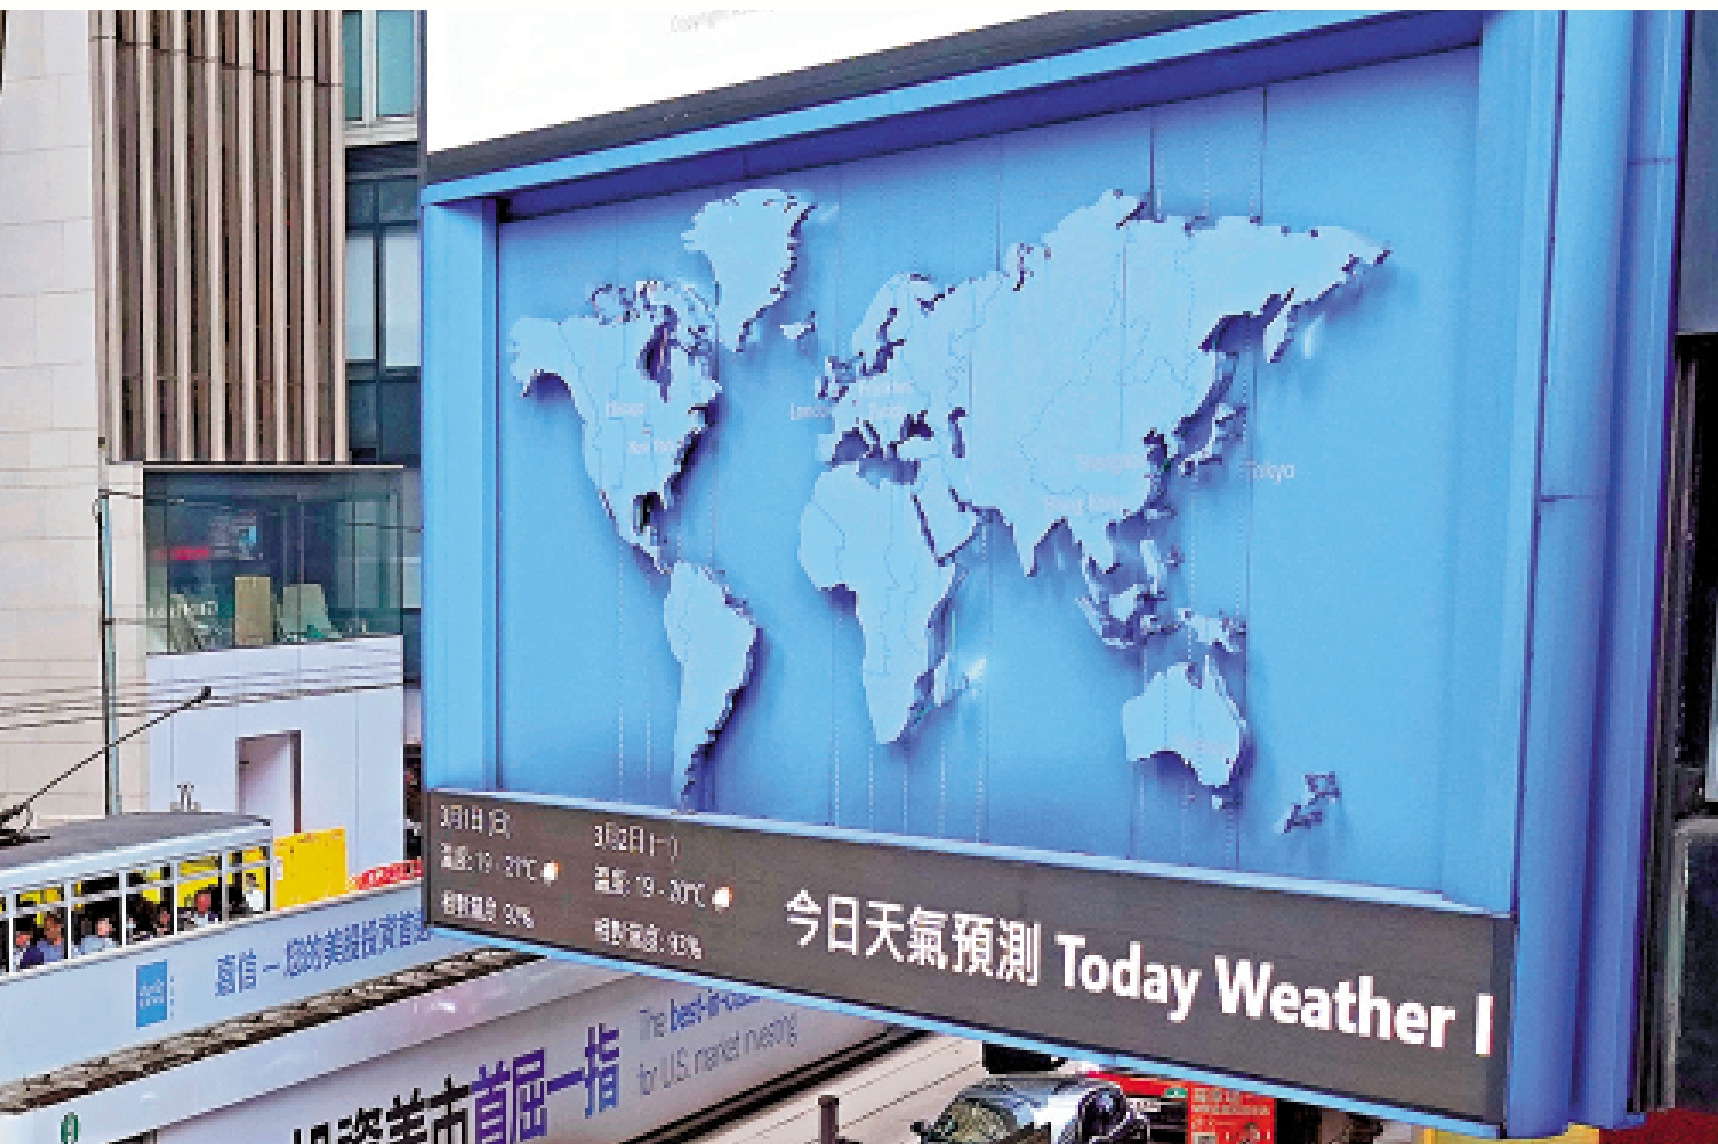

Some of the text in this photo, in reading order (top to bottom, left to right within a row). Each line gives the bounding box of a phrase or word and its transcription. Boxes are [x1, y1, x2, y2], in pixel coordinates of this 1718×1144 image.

[785, 887, 1042, 986] 今日天氣預測
[1054, 932, 1203, 1023] Today
[1213, 953, 1456, 1049] Weather
[638, 1004, 668, 1041] The
[635, 1062, 658, 1097] for
